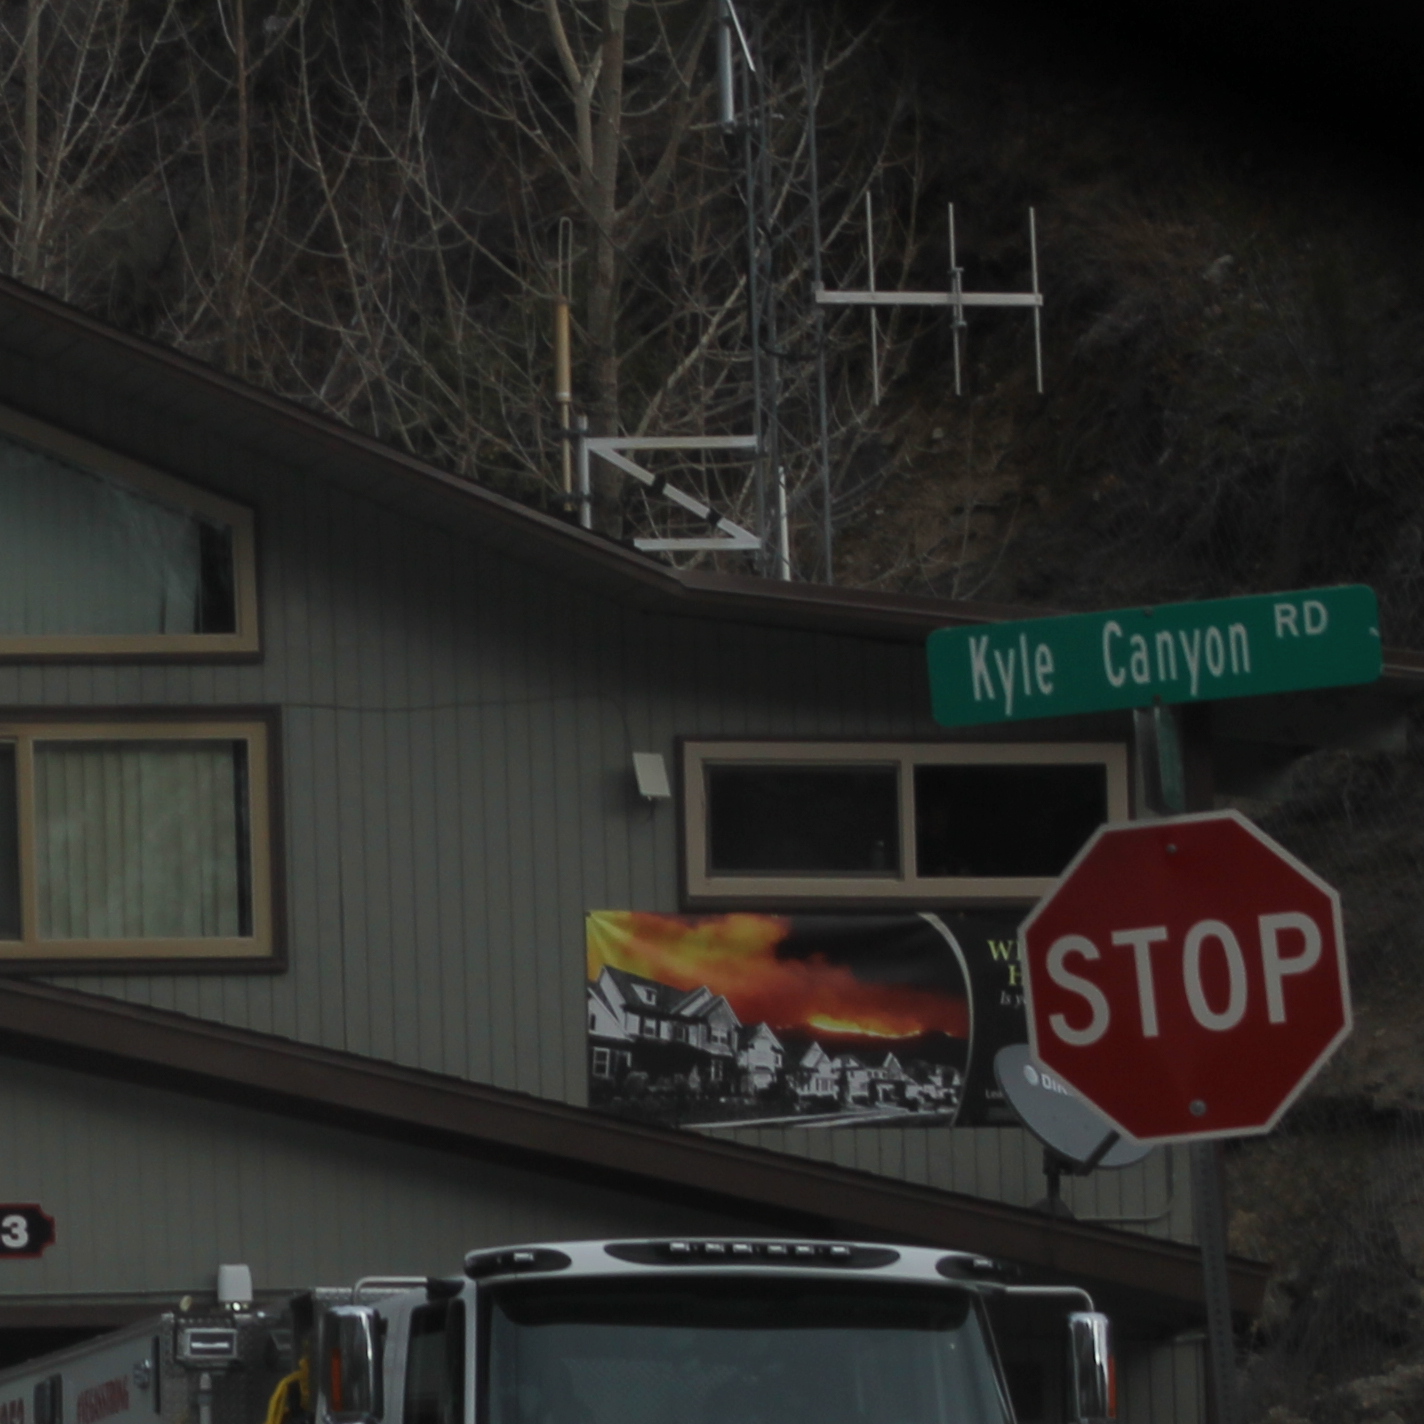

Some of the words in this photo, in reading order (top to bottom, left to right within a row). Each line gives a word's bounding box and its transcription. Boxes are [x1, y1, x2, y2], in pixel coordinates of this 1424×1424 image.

[969, 632, 1054, 716] Kyle
[1102, 619, 1250, 697] Canyon
[1273, 600, 1329, 638] RD
[1046, 911, 1323, 1047] STOP
